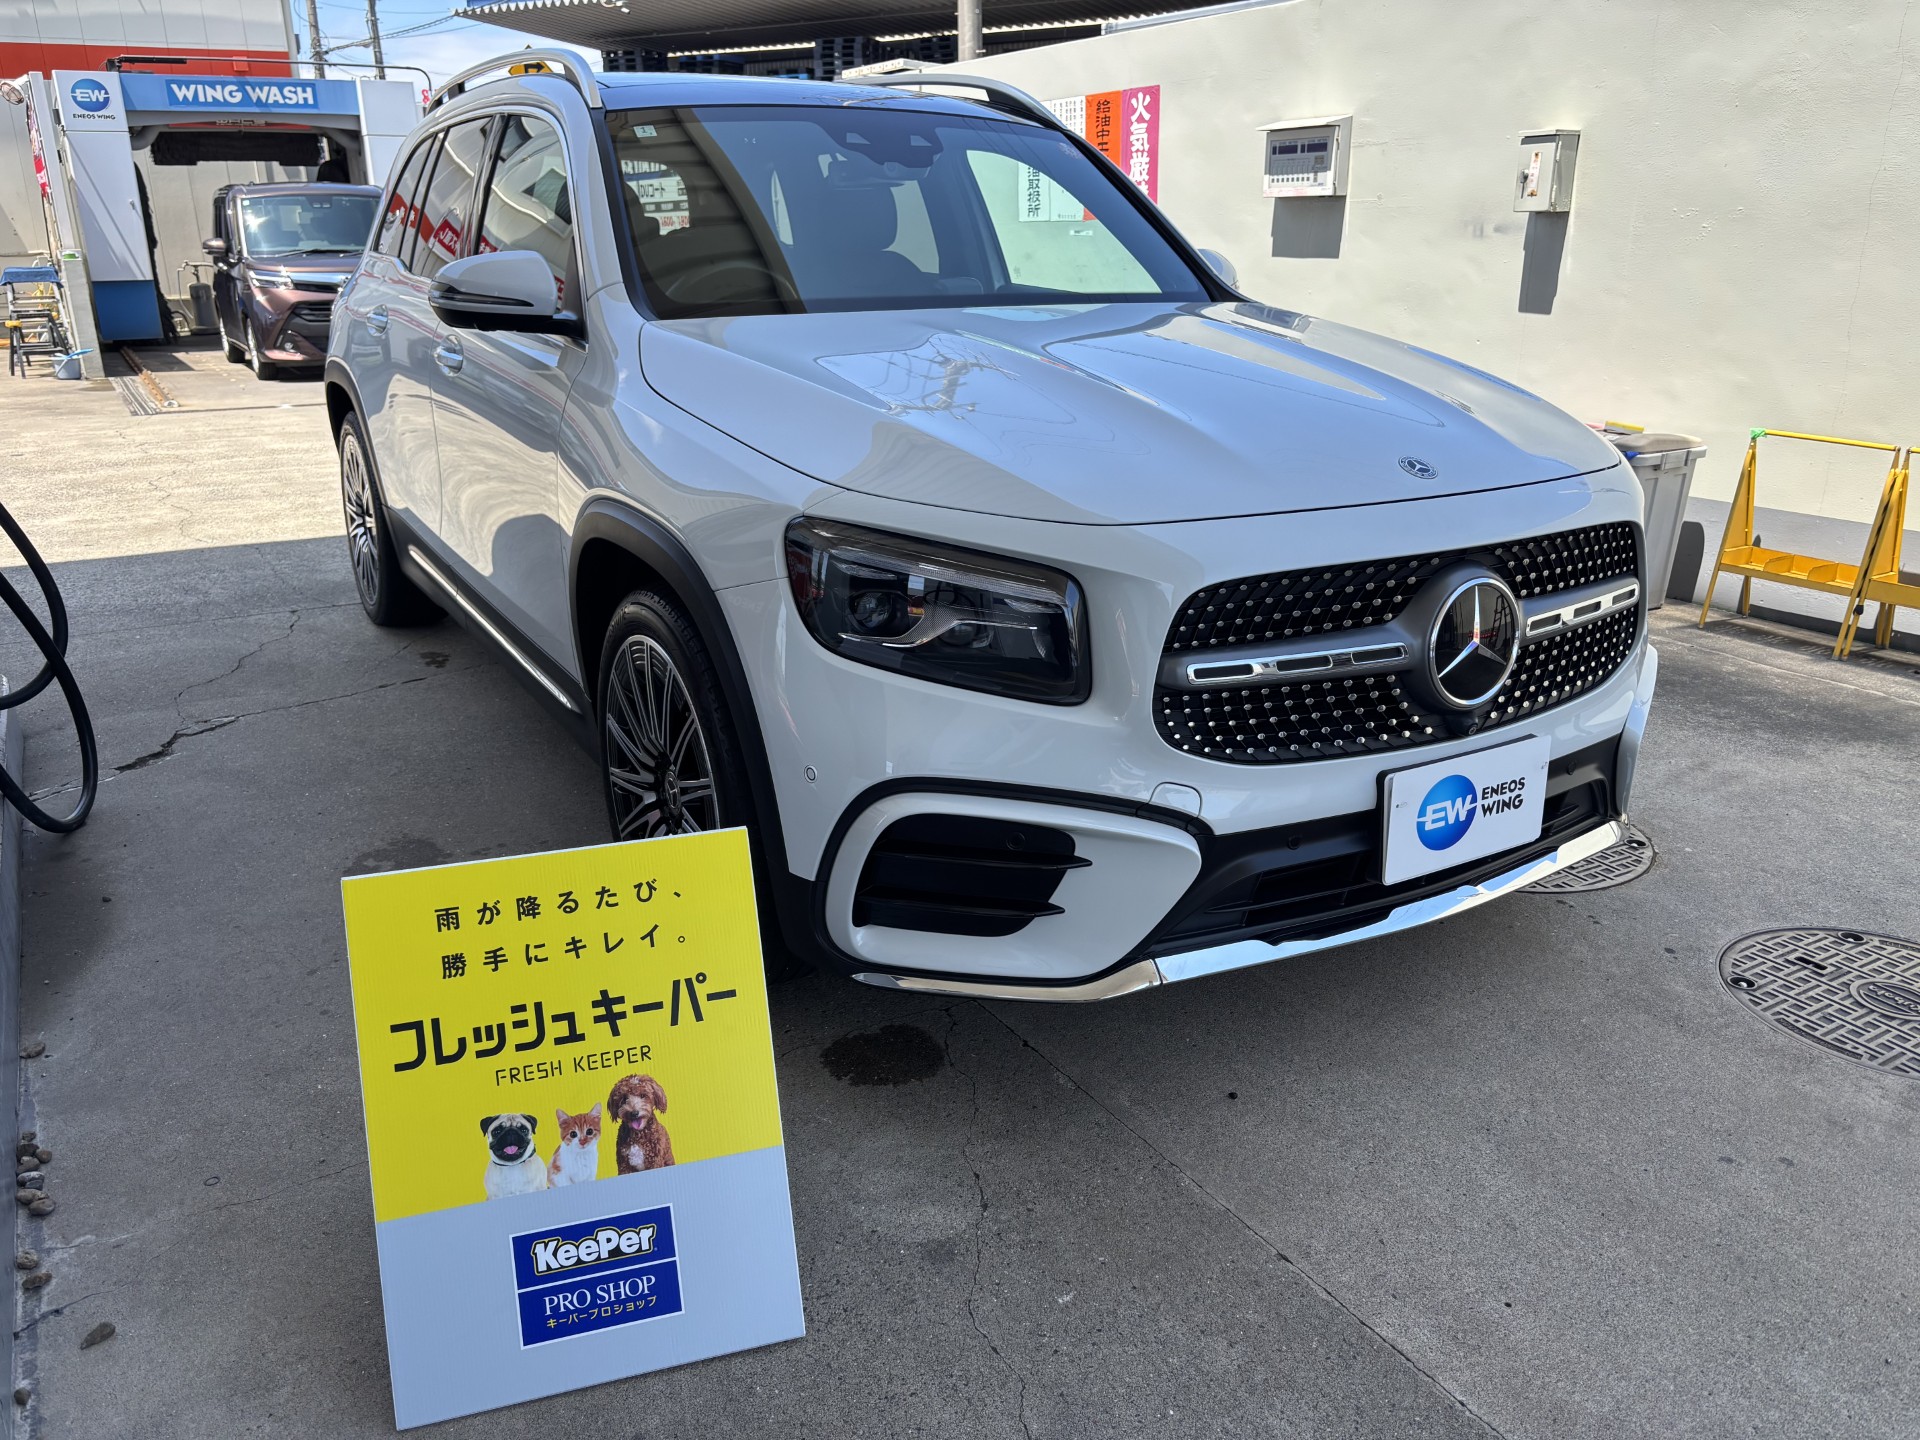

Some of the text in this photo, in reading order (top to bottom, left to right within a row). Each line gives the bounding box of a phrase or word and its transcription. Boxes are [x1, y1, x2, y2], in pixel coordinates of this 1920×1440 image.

[170, 83, 315, 105] WING WASH
[1095, 98, 1111, 157] 給油中エ
[1481, 777, 1526, 801] ENEOS
[1481, 794, 1524, 818] WING
[1425, 794, 1473, 831] EW
[434, 877, 683, 933] 雨が降るたび、
[441, 923, 686, 980] 勝手にキレイ。
[390, 971, 738, 1073] フレッシュキーパー
[495, 1044, 653, 1086] FRESH KEEPER
[533, 1225, 654, 1273] KeePer
[543, 1275, 656, 1316] PRO SHOP
